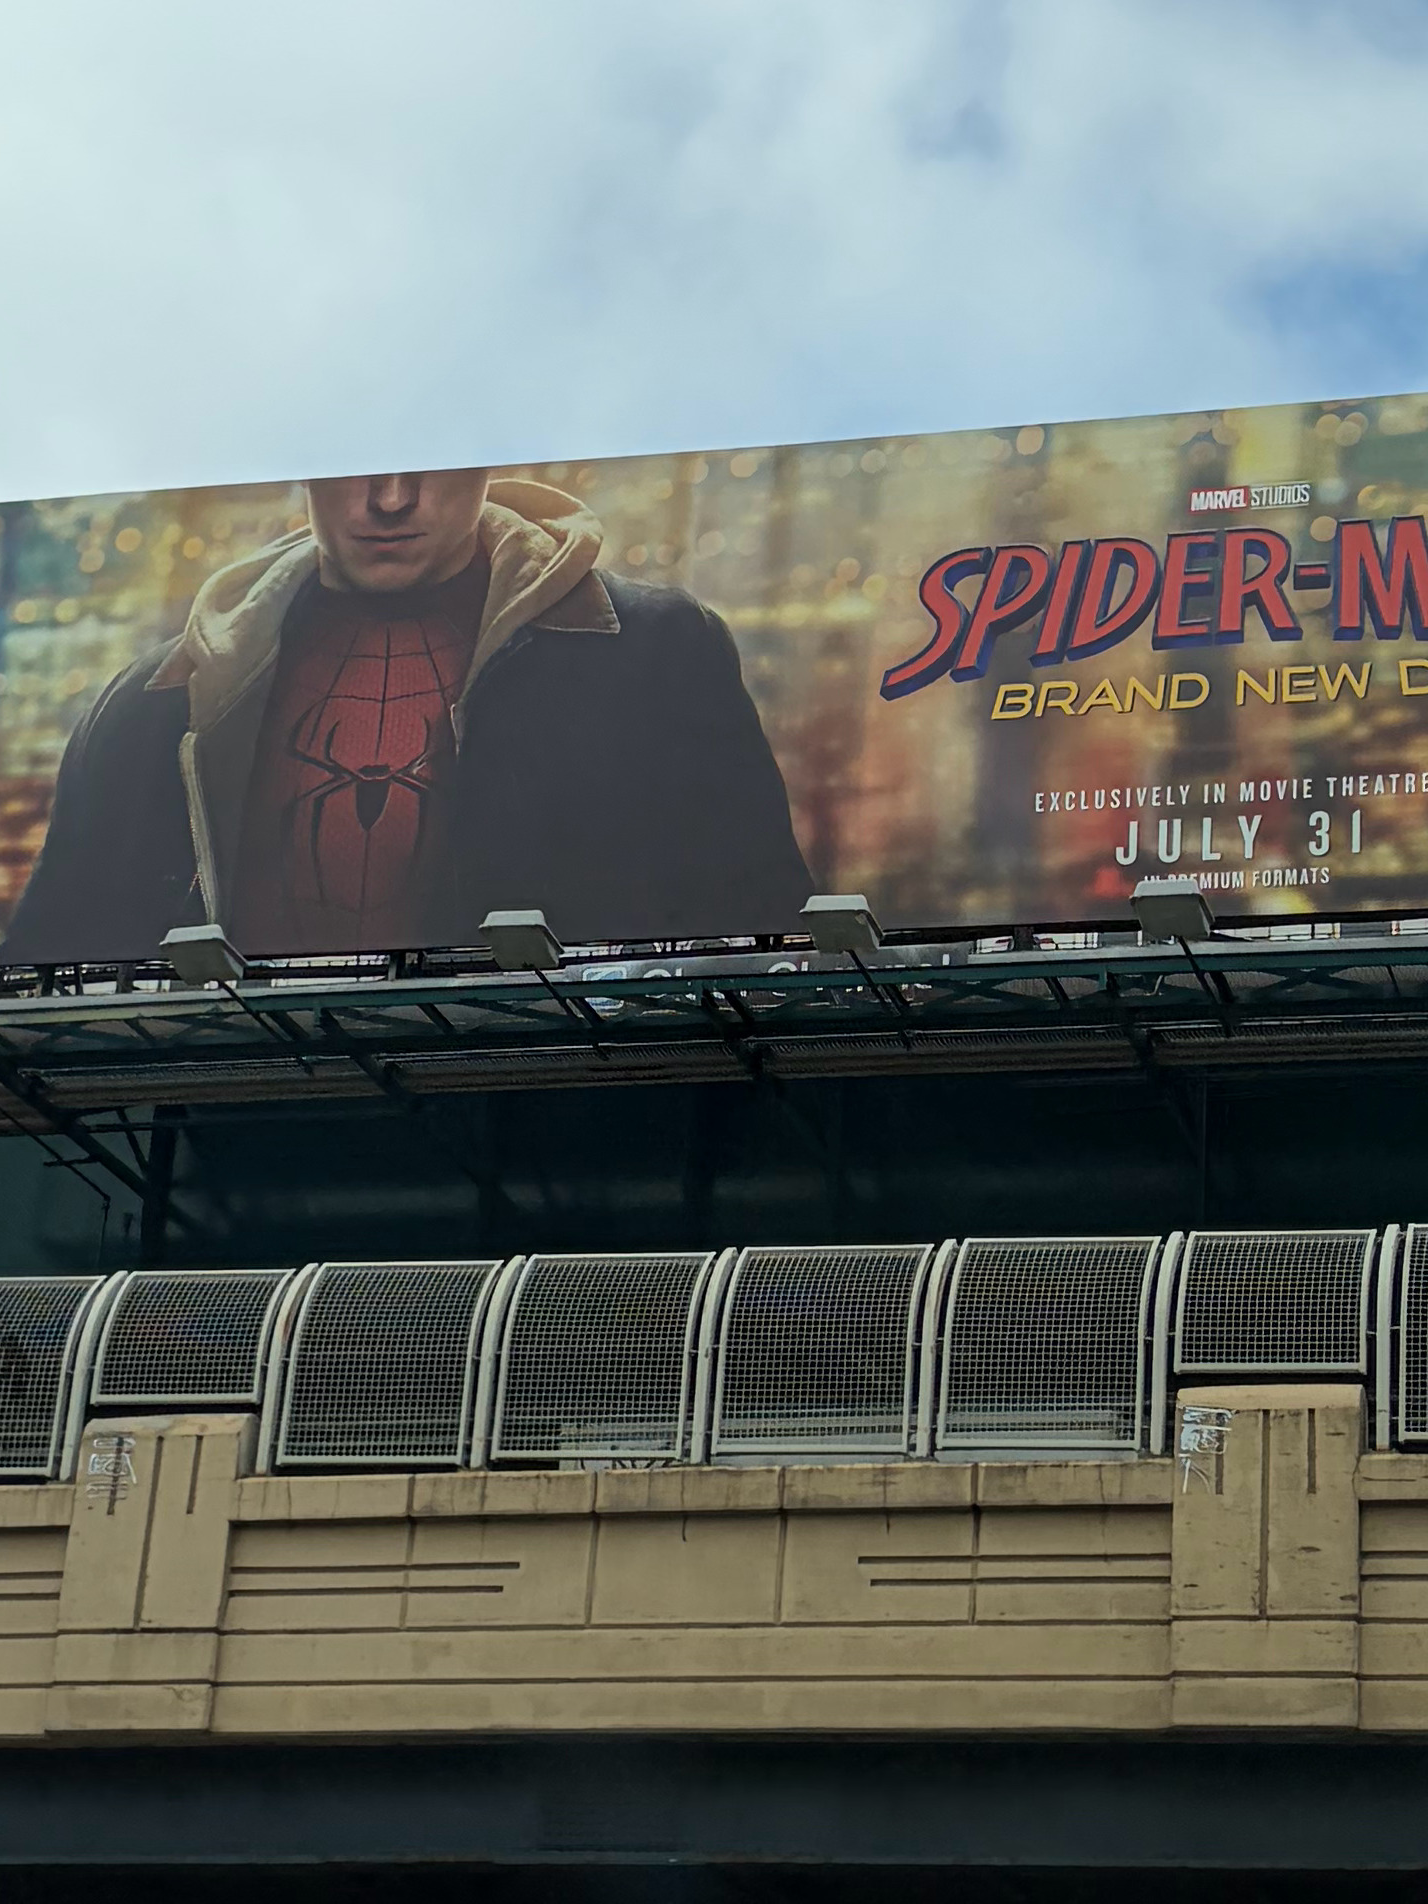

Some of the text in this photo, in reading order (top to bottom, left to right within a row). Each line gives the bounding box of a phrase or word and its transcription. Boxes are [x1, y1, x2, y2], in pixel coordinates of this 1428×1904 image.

[1190, 483, 1311, 512] MARVEL STUDIOS
[990, 671, 1211, 721] BRAND
[1235, 662, 1372, 705] NEW
[1034, 784, 1191, 813] EXCLUSIVELY
[1202, 783, 1227, 805] IN
[1239, 777, 1314, 803] MOVIE
[1115, 808, 1363, 866] JULY 31
[1252, 866, 1331, 887] FORMATS
